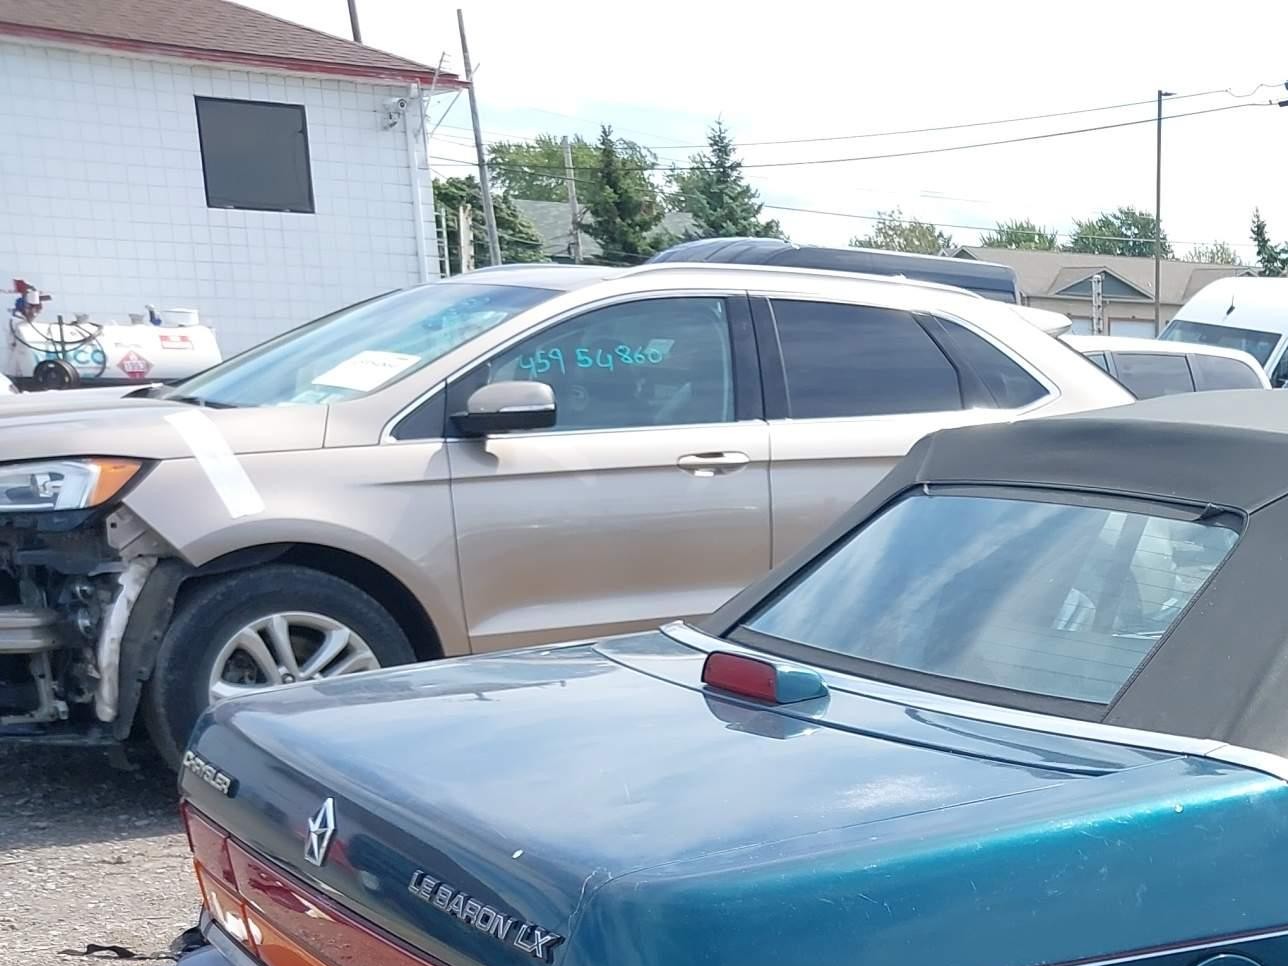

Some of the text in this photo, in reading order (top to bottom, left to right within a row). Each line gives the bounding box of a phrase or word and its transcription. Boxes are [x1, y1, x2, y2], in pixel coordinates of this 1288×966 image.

[518, 344, 664, 379] 459 54860
[183, 750, 231, 794] CHRYSLER
[408, 869, 562, 959] LE BARON LX
